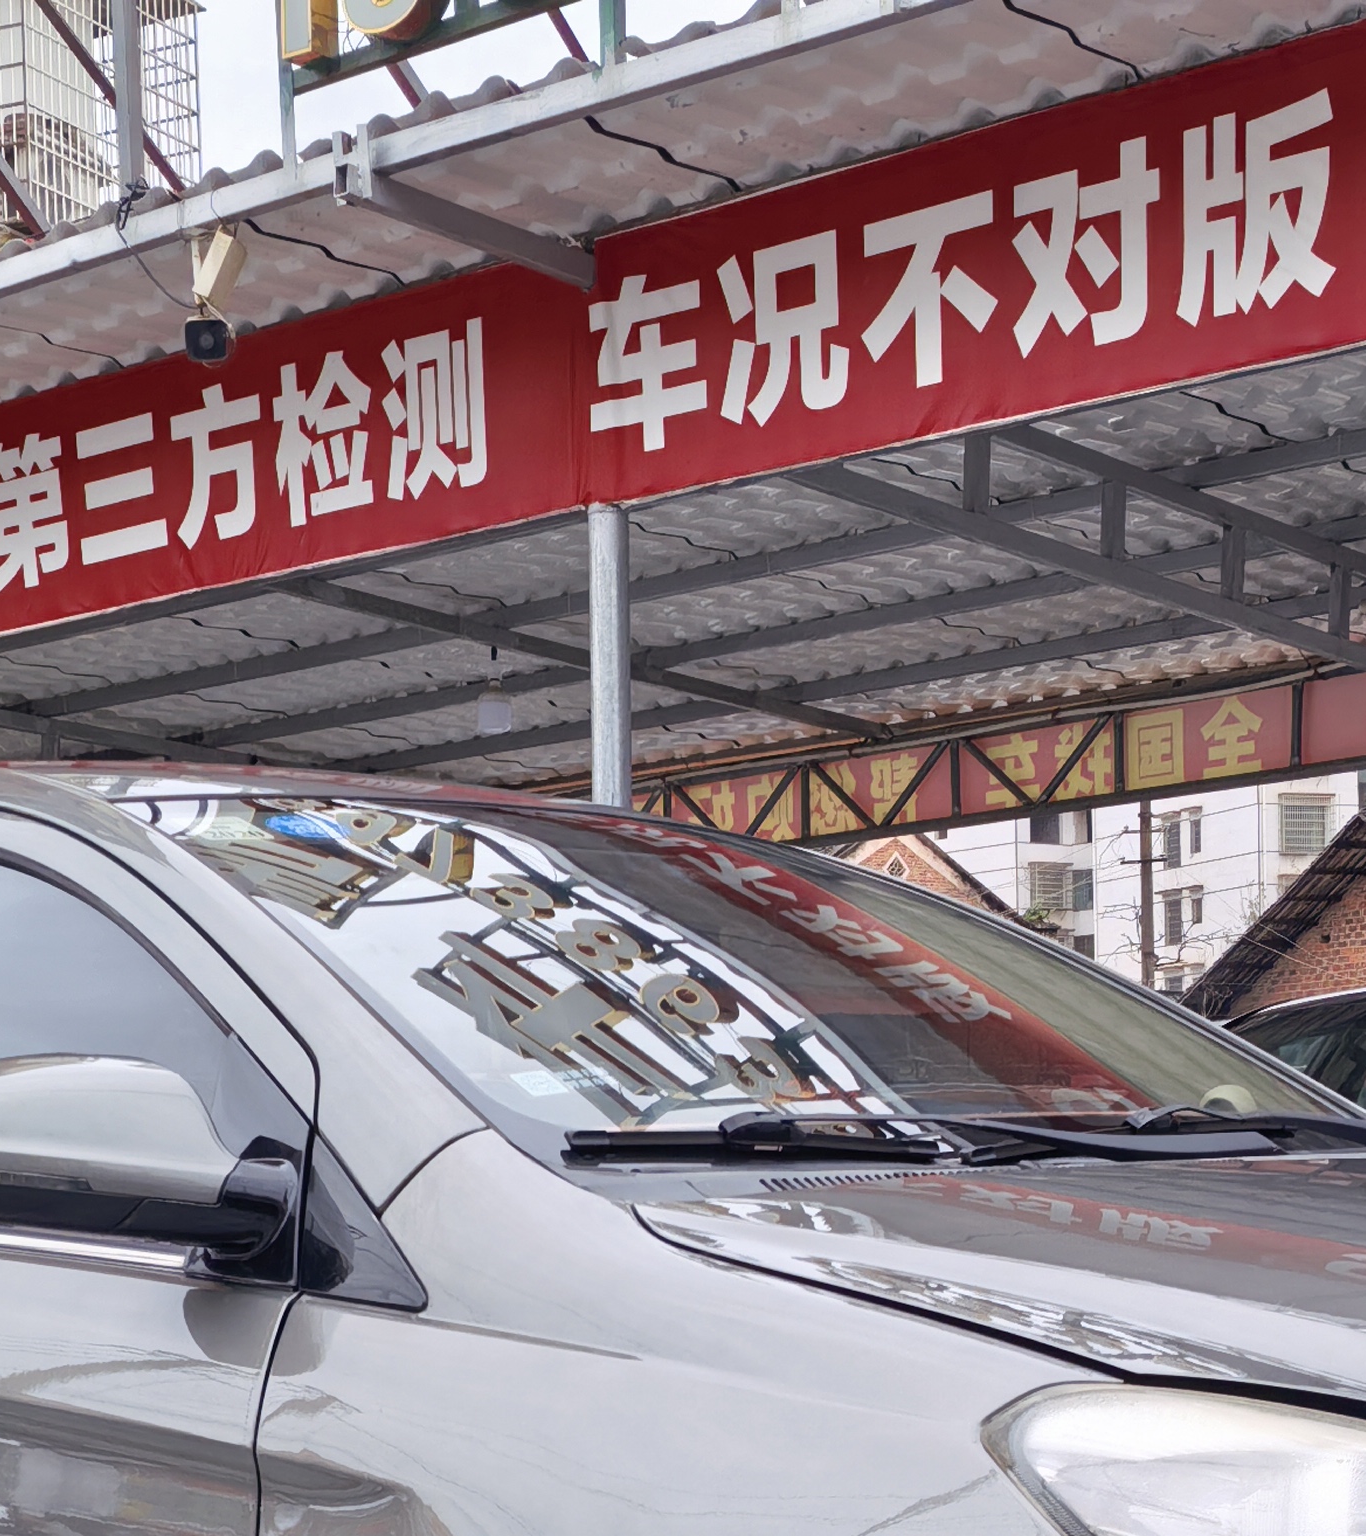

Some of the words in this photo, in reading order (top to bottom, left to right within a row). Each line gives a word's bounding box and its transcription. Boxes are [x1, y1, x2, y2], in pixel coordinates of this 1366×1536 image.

[588, 87, 1337, 452] 车况不对版
